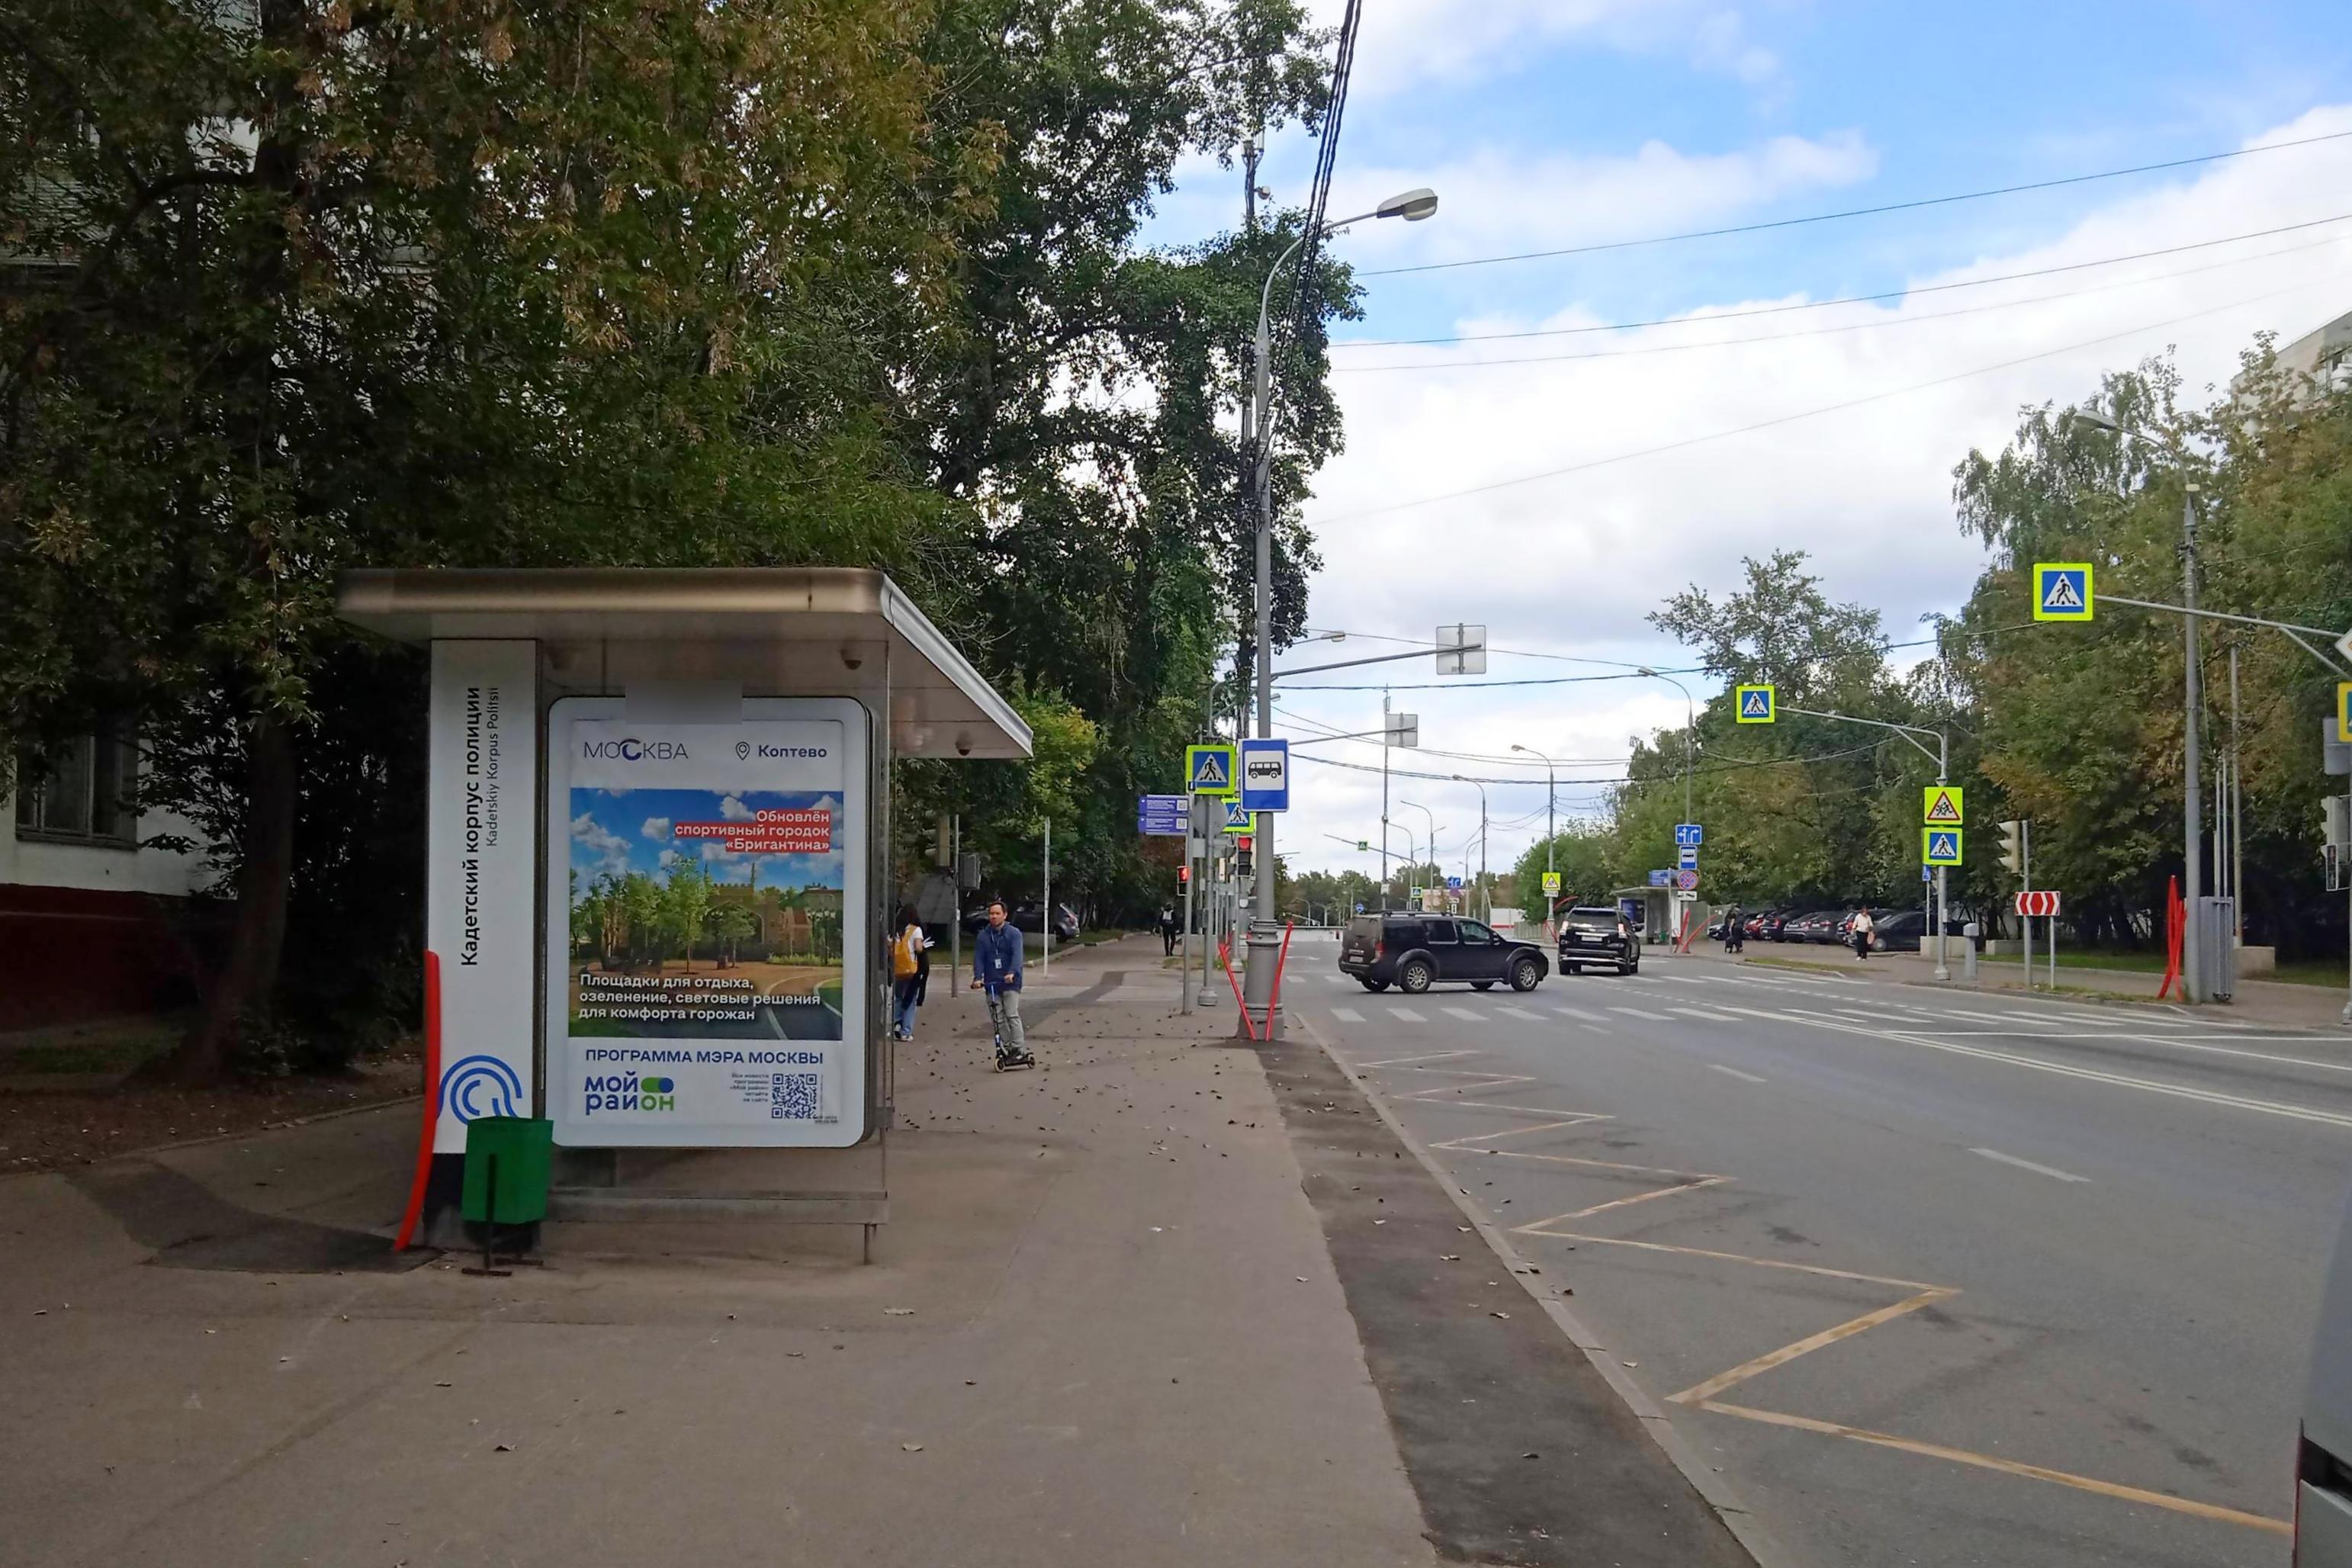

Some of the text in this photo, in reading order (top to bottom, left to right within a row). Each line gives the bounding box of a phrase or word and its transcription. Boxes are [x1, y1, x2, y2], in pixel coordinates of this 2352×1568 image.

[583, 738, 689, 761] МОСКВА
[758, 744, 827, 758] Коптево
[486, 686, 500, 847] Kadetskiy Korpus Politsii
[757, 810, 830, 822] Обновлён
[461, 687, 484, 966] Кадетский корпус полиции
[675, 824, 830, 838] спортивный городок
[726, 838, 830, 852] «Бригантина»
[580, 974, 753, 991] Площадки для отдыха,
[580, 991, 821, 1006] озеленение, световые решения
[579, 1007, 755, 1022] для комфорта горожан
[586, 1049, 824, 1065] ПРОГРАММА МЭРА МОСКВЫ
